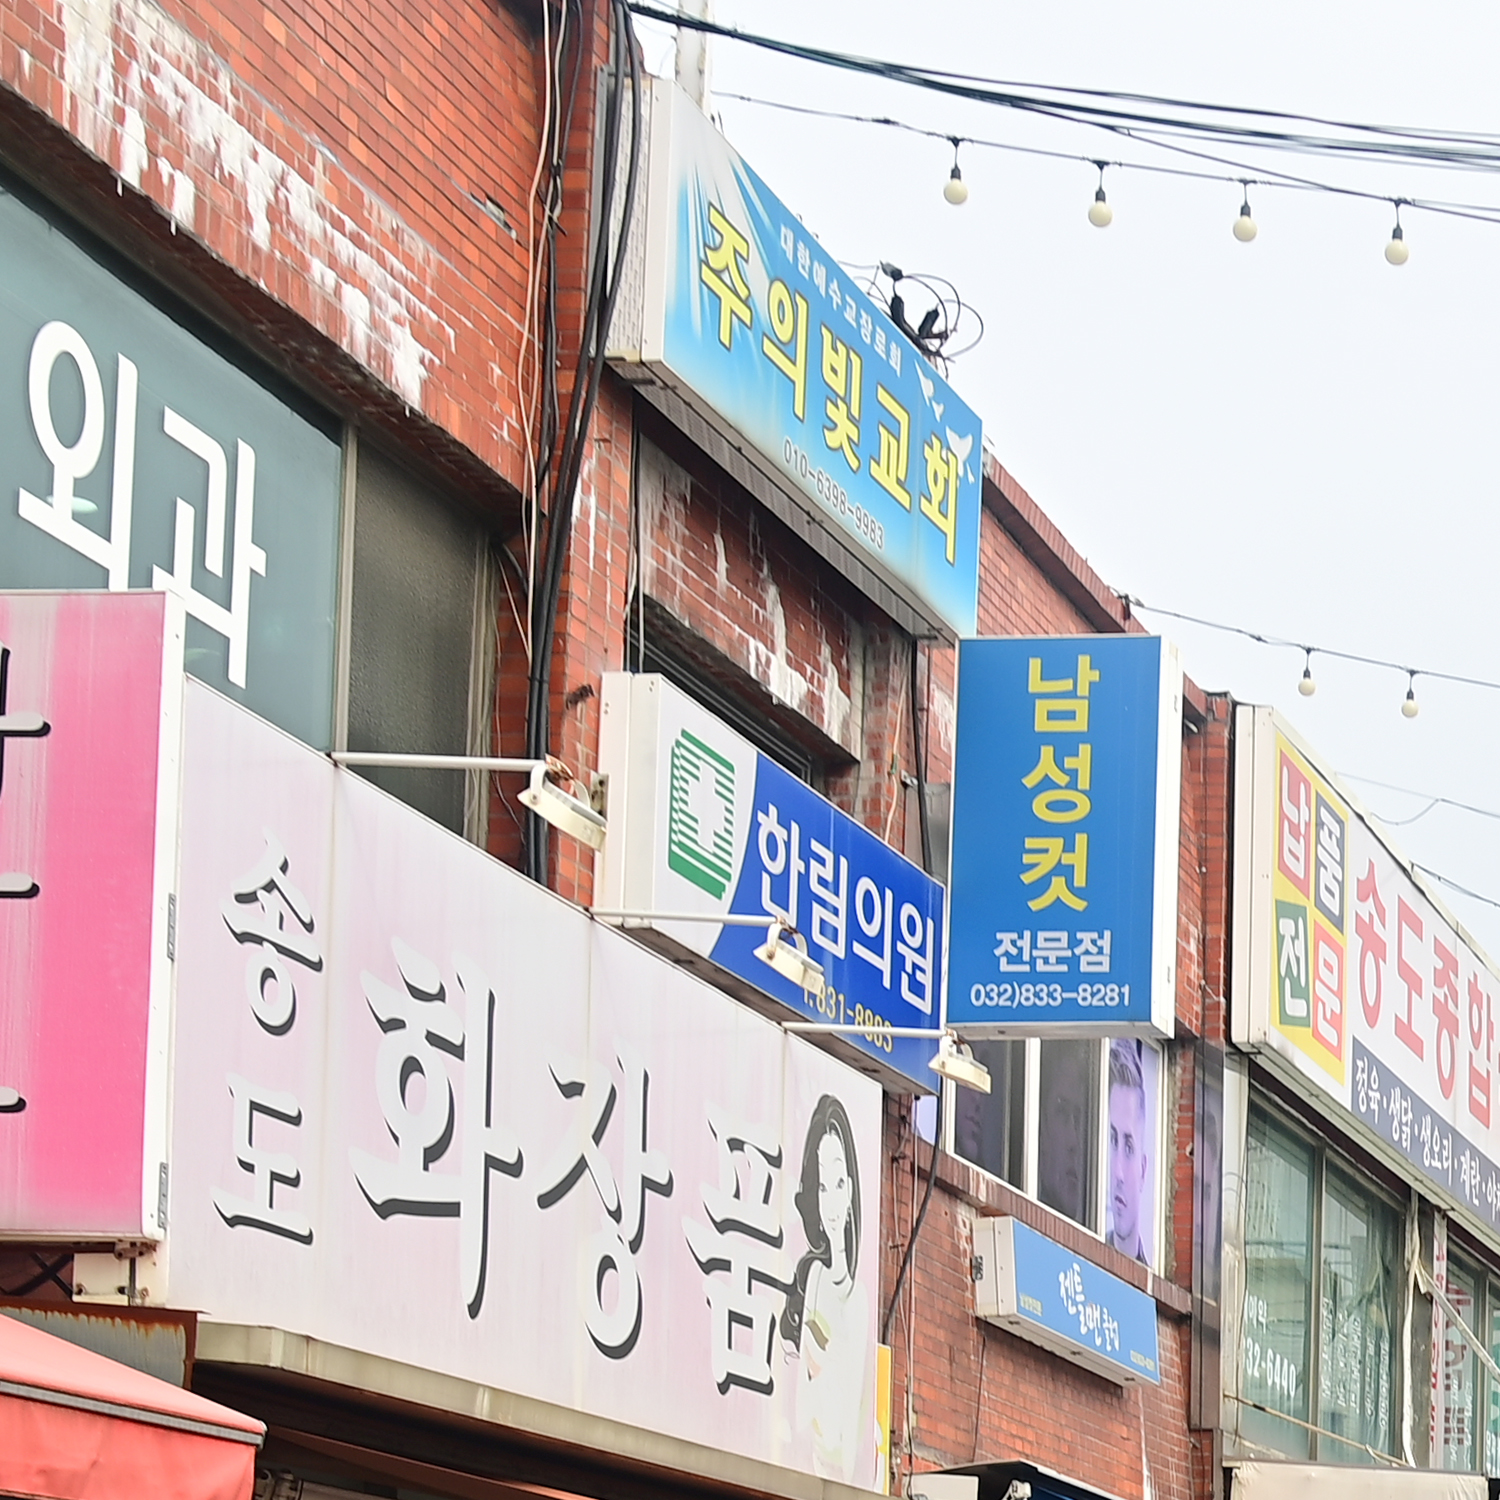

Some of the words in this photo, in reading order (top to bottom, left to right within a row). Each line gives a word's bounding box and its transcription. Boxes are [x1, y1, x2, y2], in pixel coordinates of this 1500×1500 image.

[700, 203, 959, 566] 주의빛교회
[780, 223, 902, 378] 대한예수교장로회
[17, 319, 268, 690] 외과
[783, 436, 886, 550] 010-6398-9983
[1021, 654, 1100, 912] 남성컷
[756, 802, 935, 1016] 한림의원
[969, 982, 1131, 1009] 032)833-8281
[993, 928, 1113, 974] 전문점
[211, 828, 324, 1247] 송도
[347, 935, 797, 1397] 화장품
